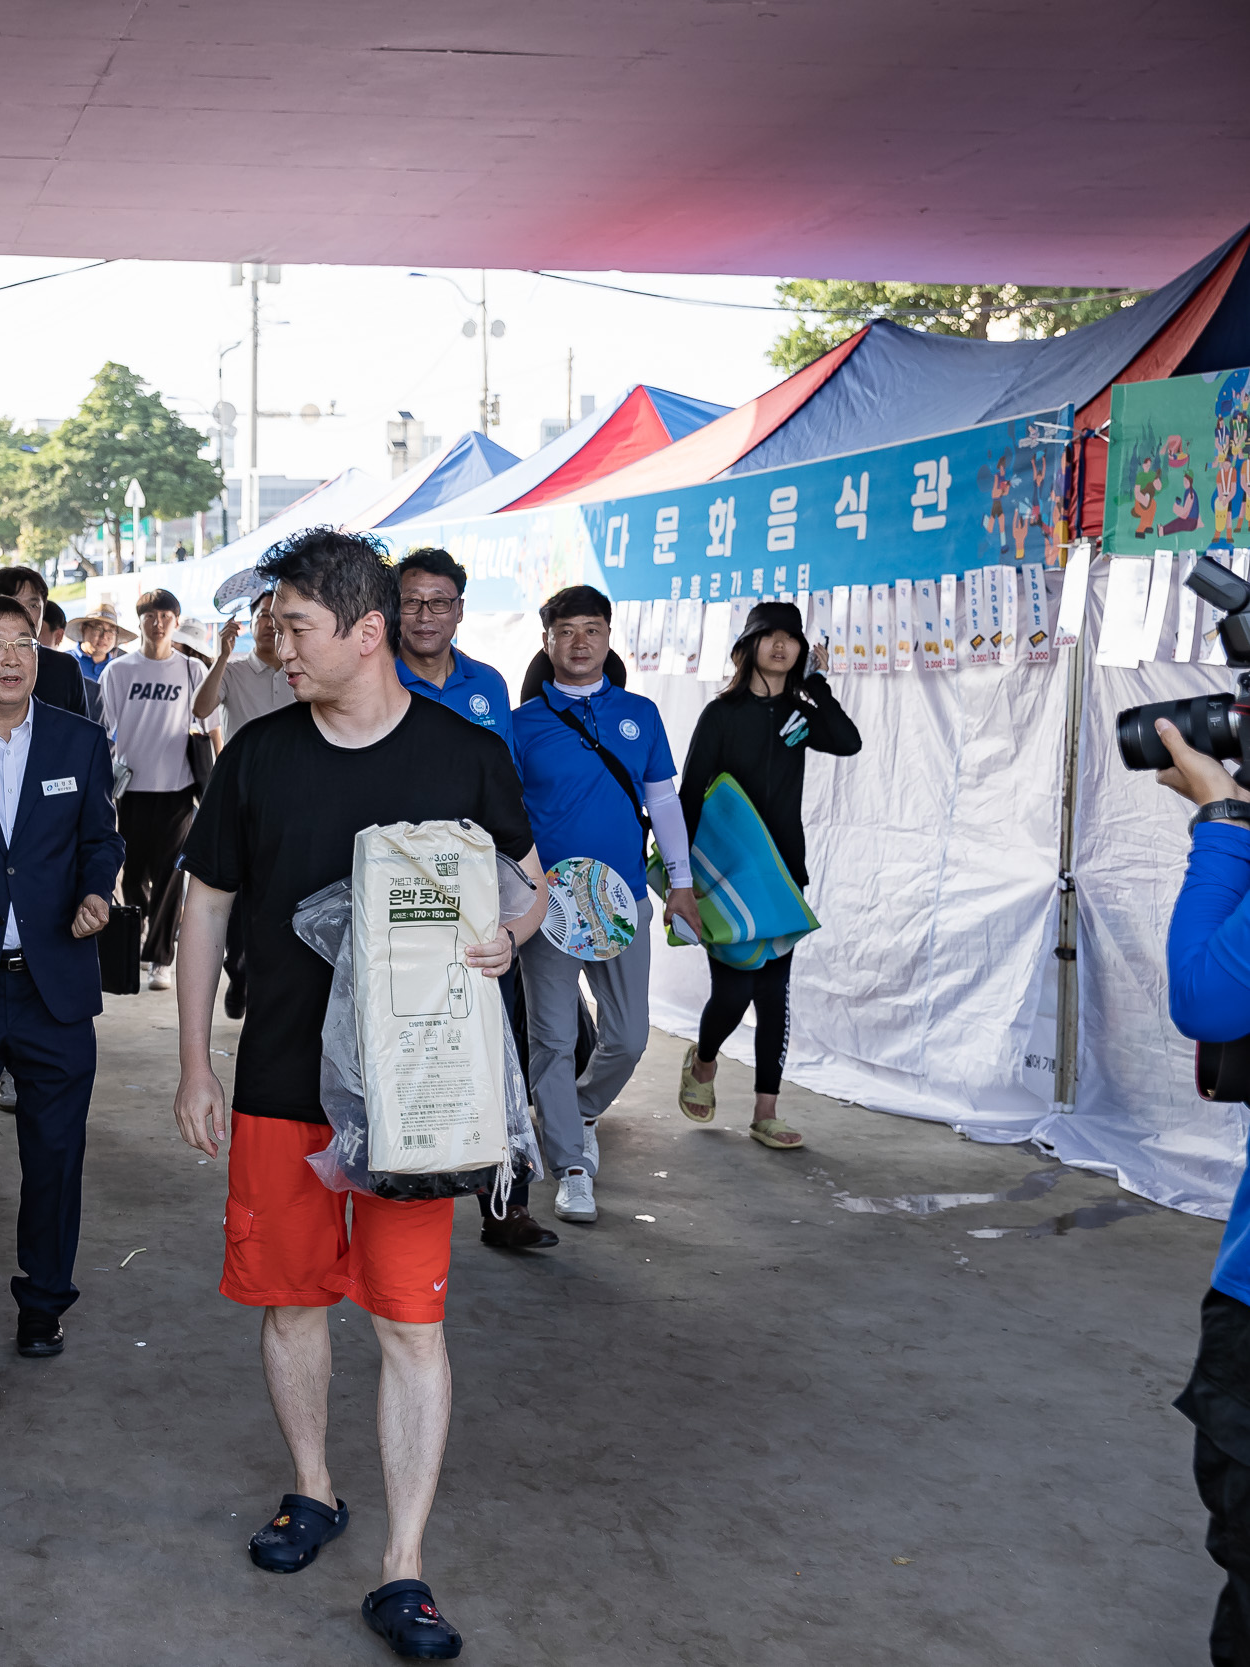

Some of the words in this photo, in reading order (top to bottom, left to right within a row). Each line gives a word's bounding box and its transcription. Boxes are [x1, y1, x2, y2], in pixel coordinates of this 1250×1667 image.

[604, 455, 952, 568] 다문화음식관
[129, 682, 182, 701] PARIS
[389, 877, 412, 887] 가볍고
[388, 889, 418, 906] 은박
[419, 889, 461, 911] 돗자리
